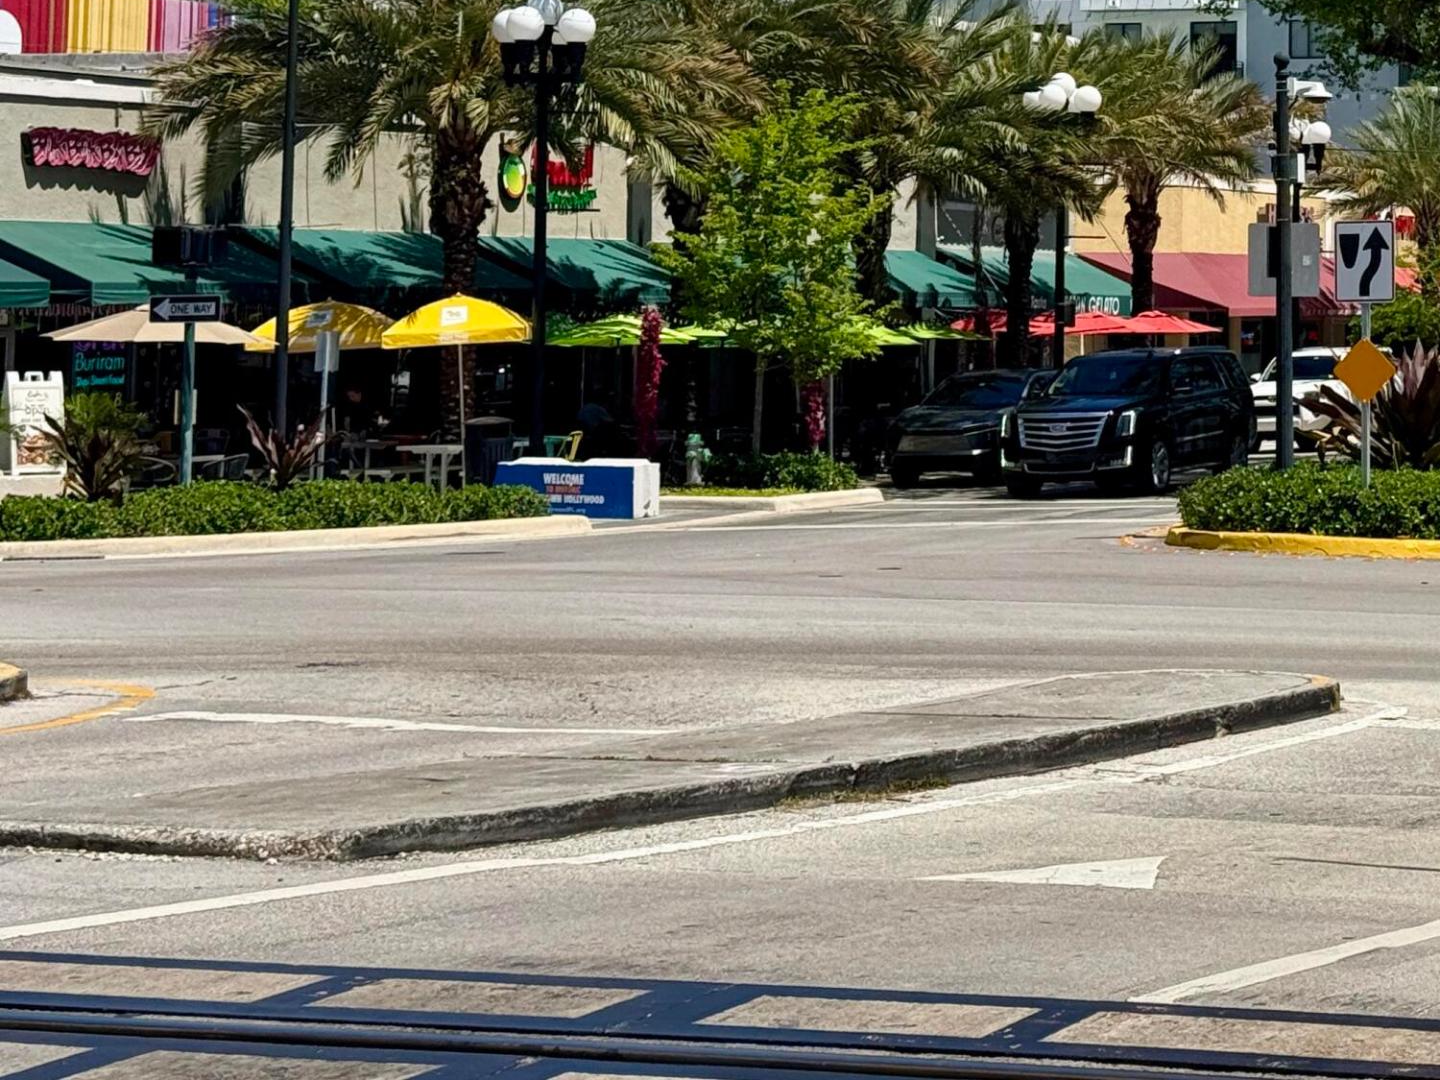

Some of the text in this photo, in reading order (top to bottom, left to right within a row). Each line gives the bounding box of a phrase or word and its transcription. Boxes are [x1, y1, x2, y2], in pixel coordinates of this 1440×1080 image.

[170, 303, 212, 314] ONE WAY
[543, 473, 584, 485] WELCOME
[564, 494, 605, 504] HOLLYWOOD
